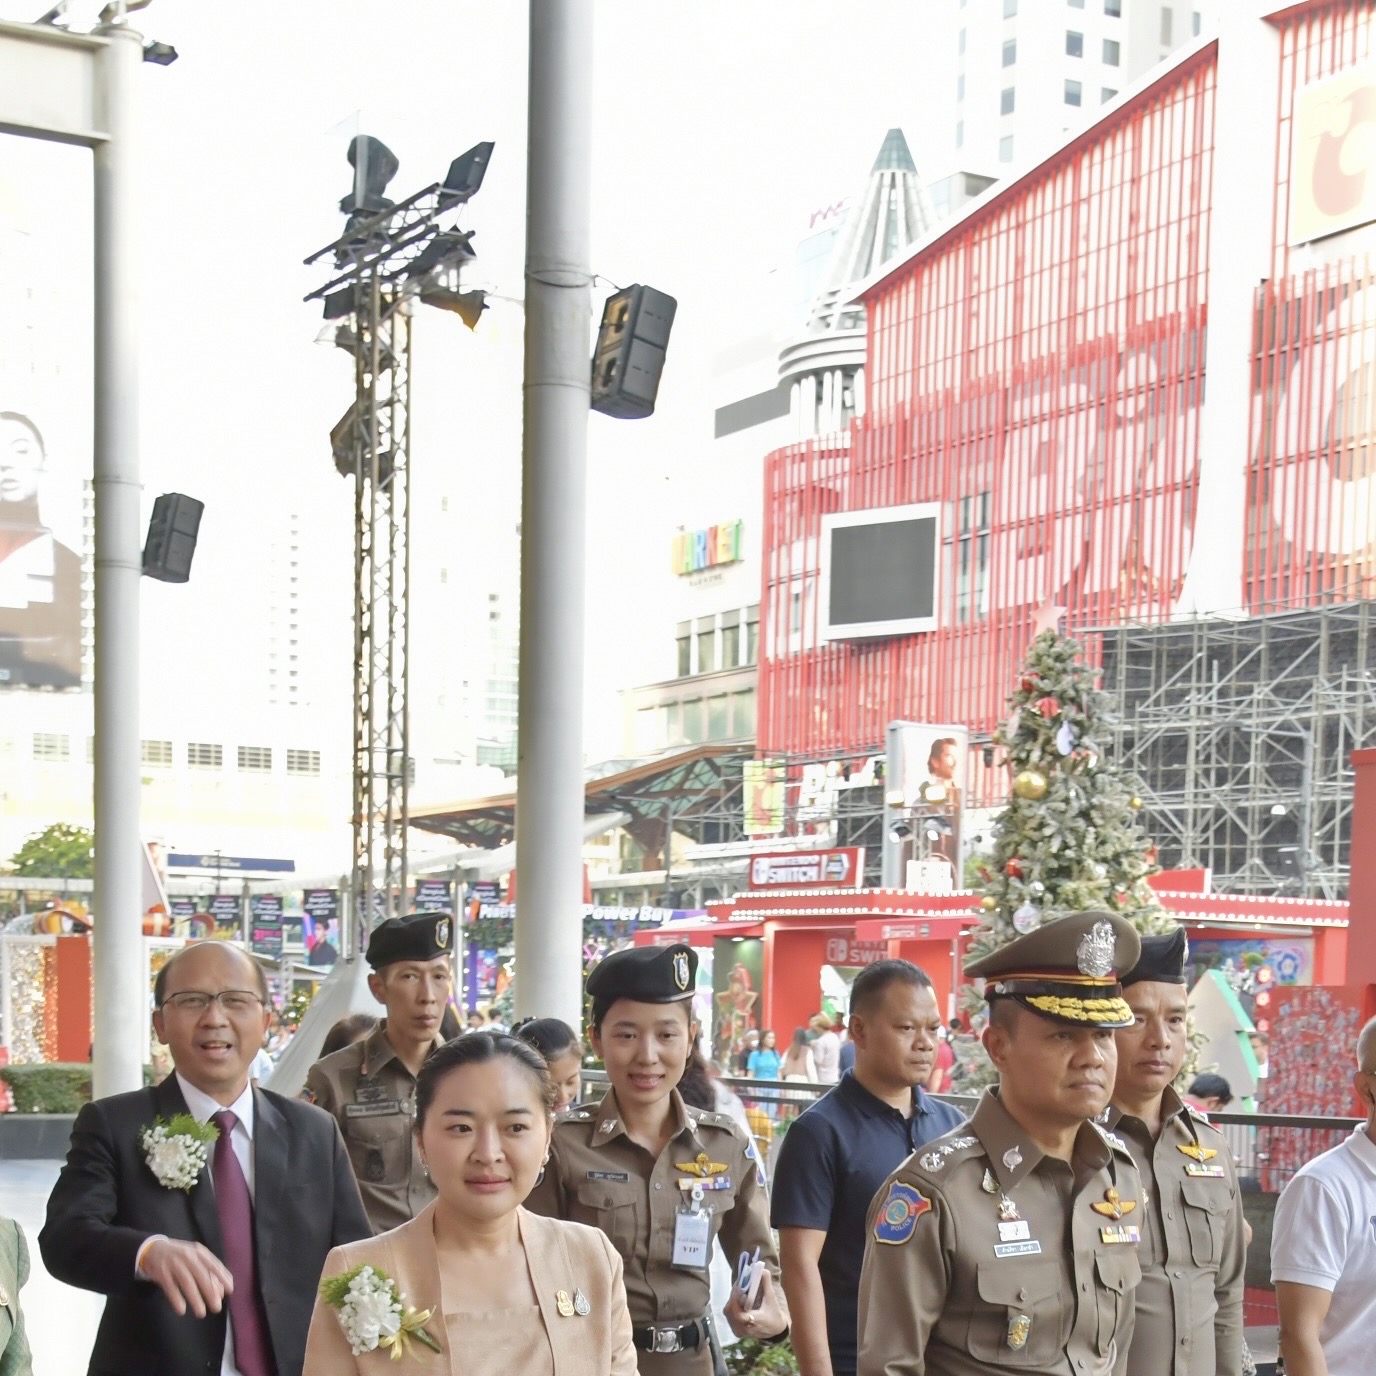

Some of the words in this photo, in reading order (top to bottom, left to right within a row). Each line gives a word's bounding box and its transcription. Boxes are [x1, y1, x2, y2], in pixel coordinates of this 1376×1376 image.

[581, 904, 639, 921] Power
[639, 905, 673, 926] Buy
[849, 948, 889, 963] SWIT
